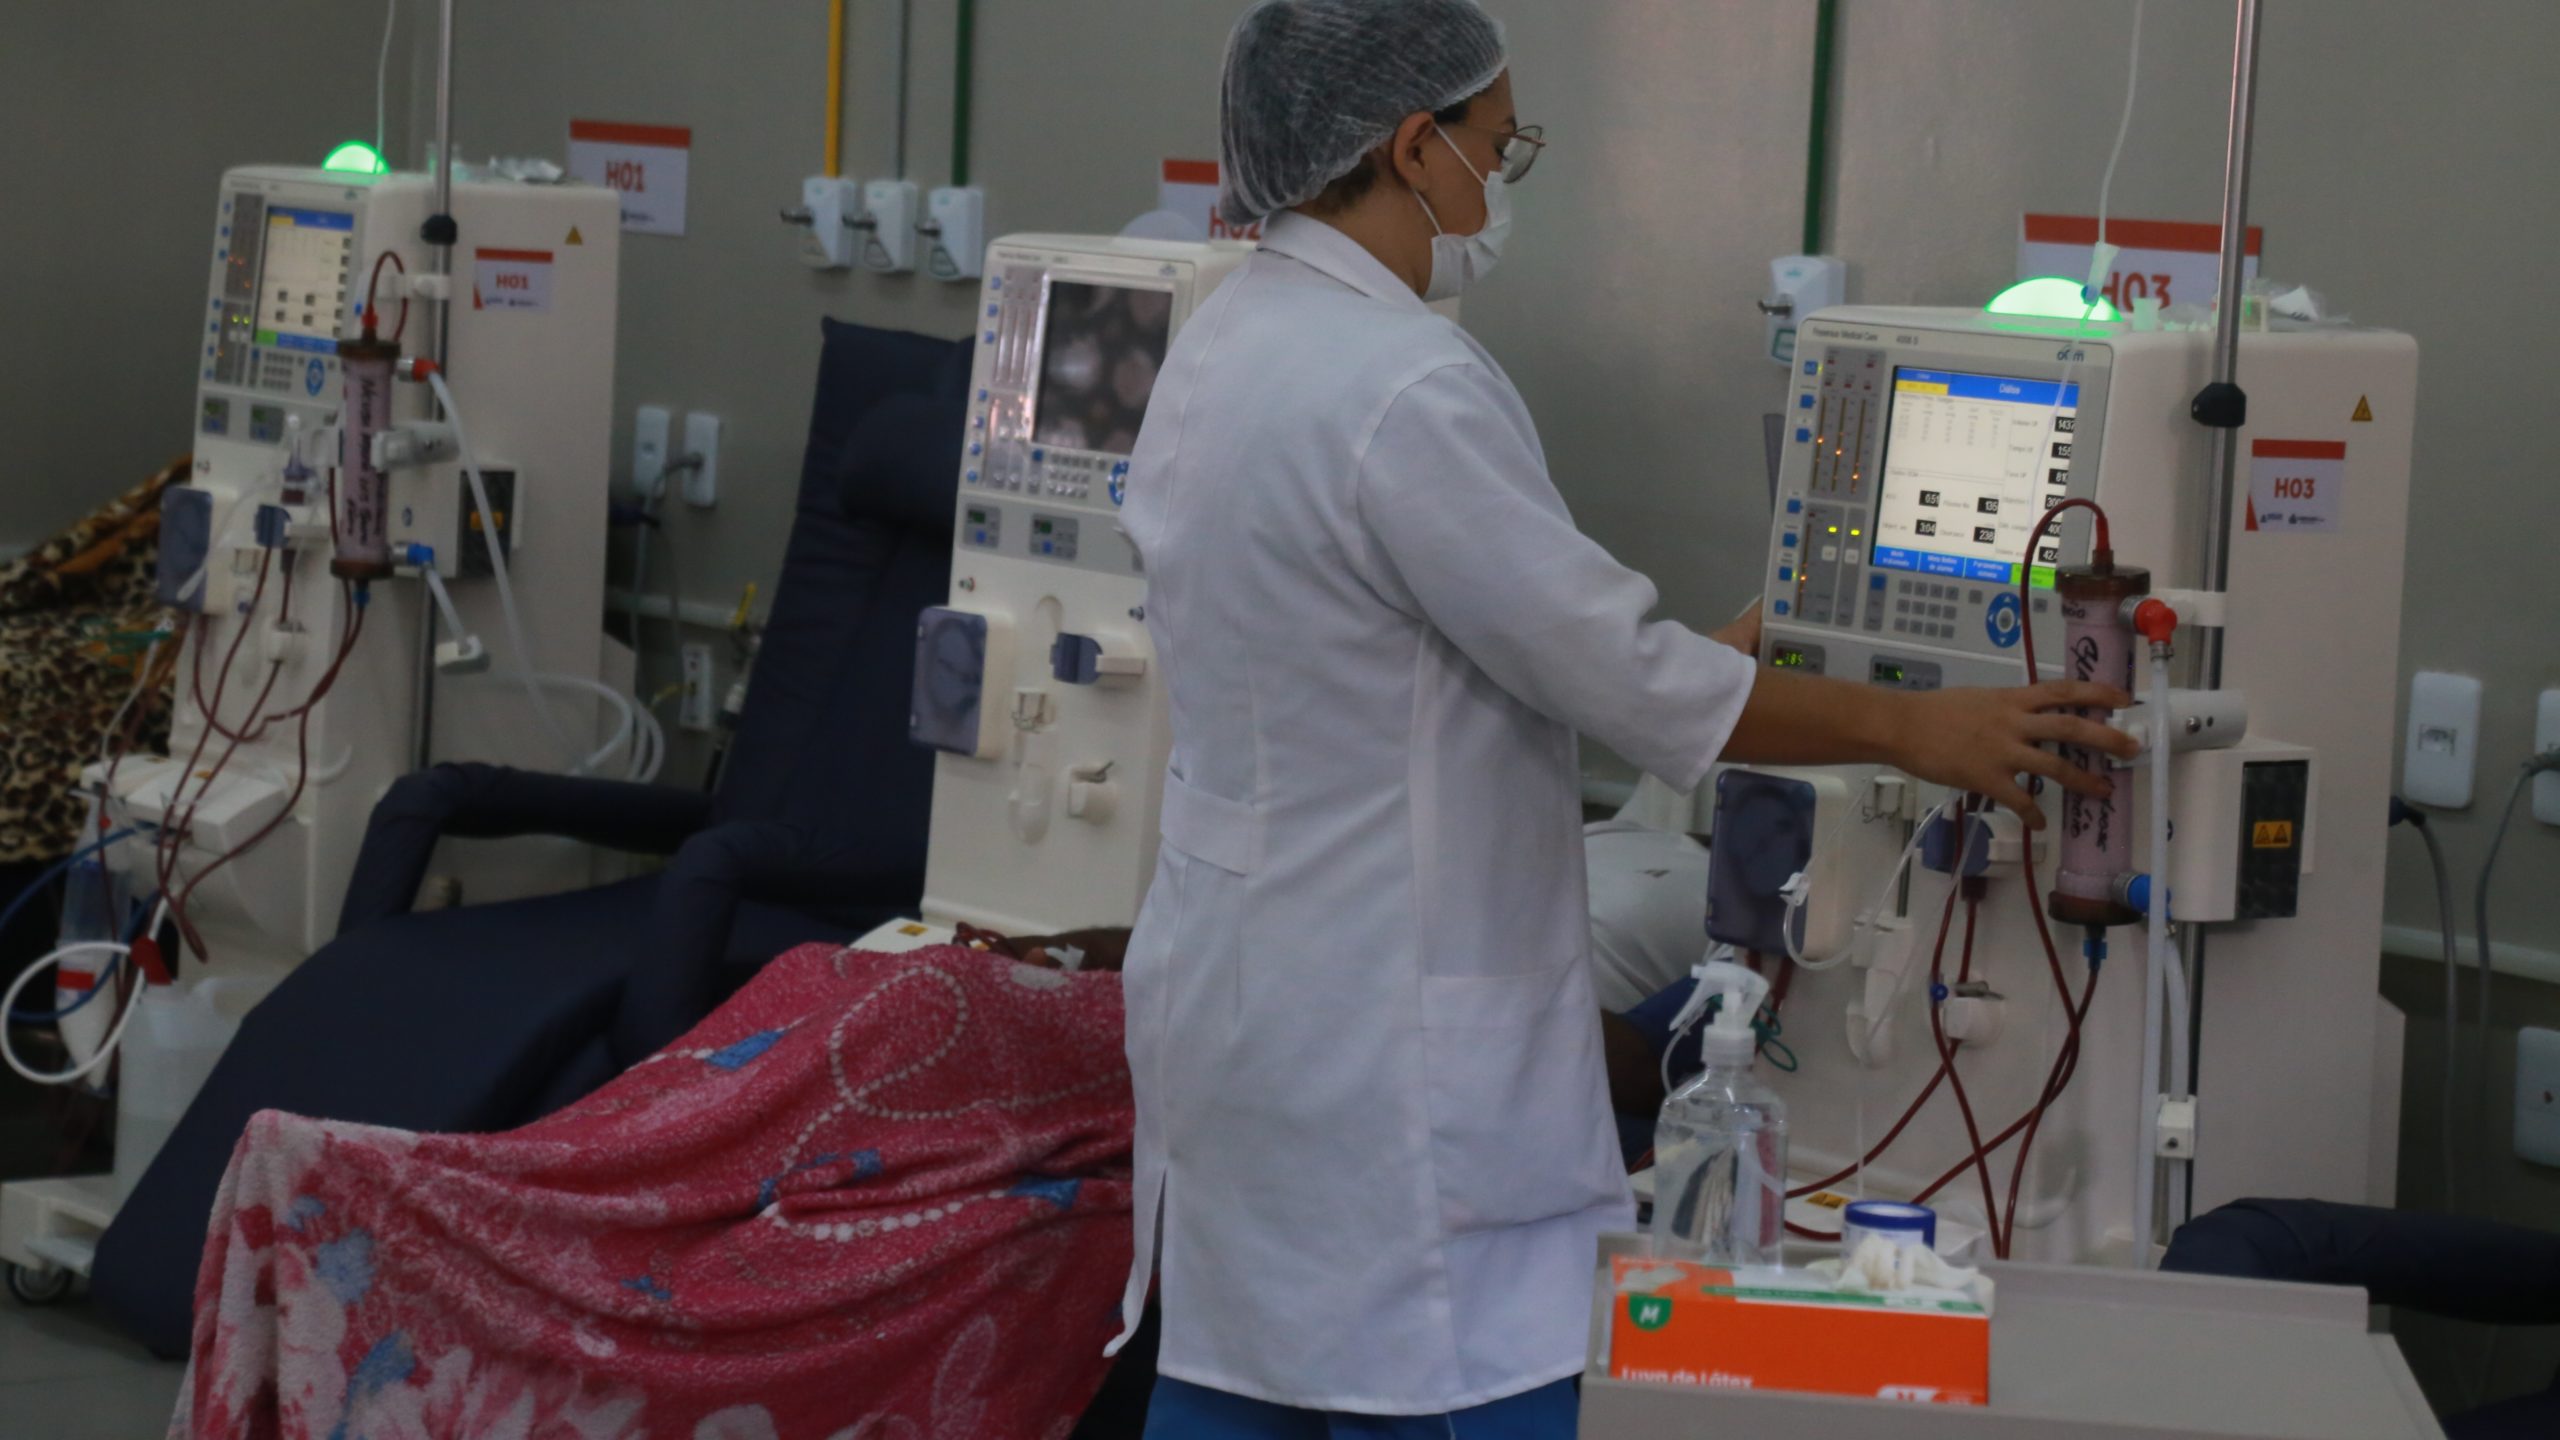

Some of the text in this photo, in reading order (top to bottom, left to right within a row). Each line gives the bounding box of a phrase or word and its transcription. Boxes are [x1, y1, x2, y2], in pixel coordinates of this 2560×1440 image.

[605, 160, 645, 192] H01
[495, 273, 529, 291] H01
[2274, 478, 2315, 499] H03
[1639, 1304, 1660, 1323] M
